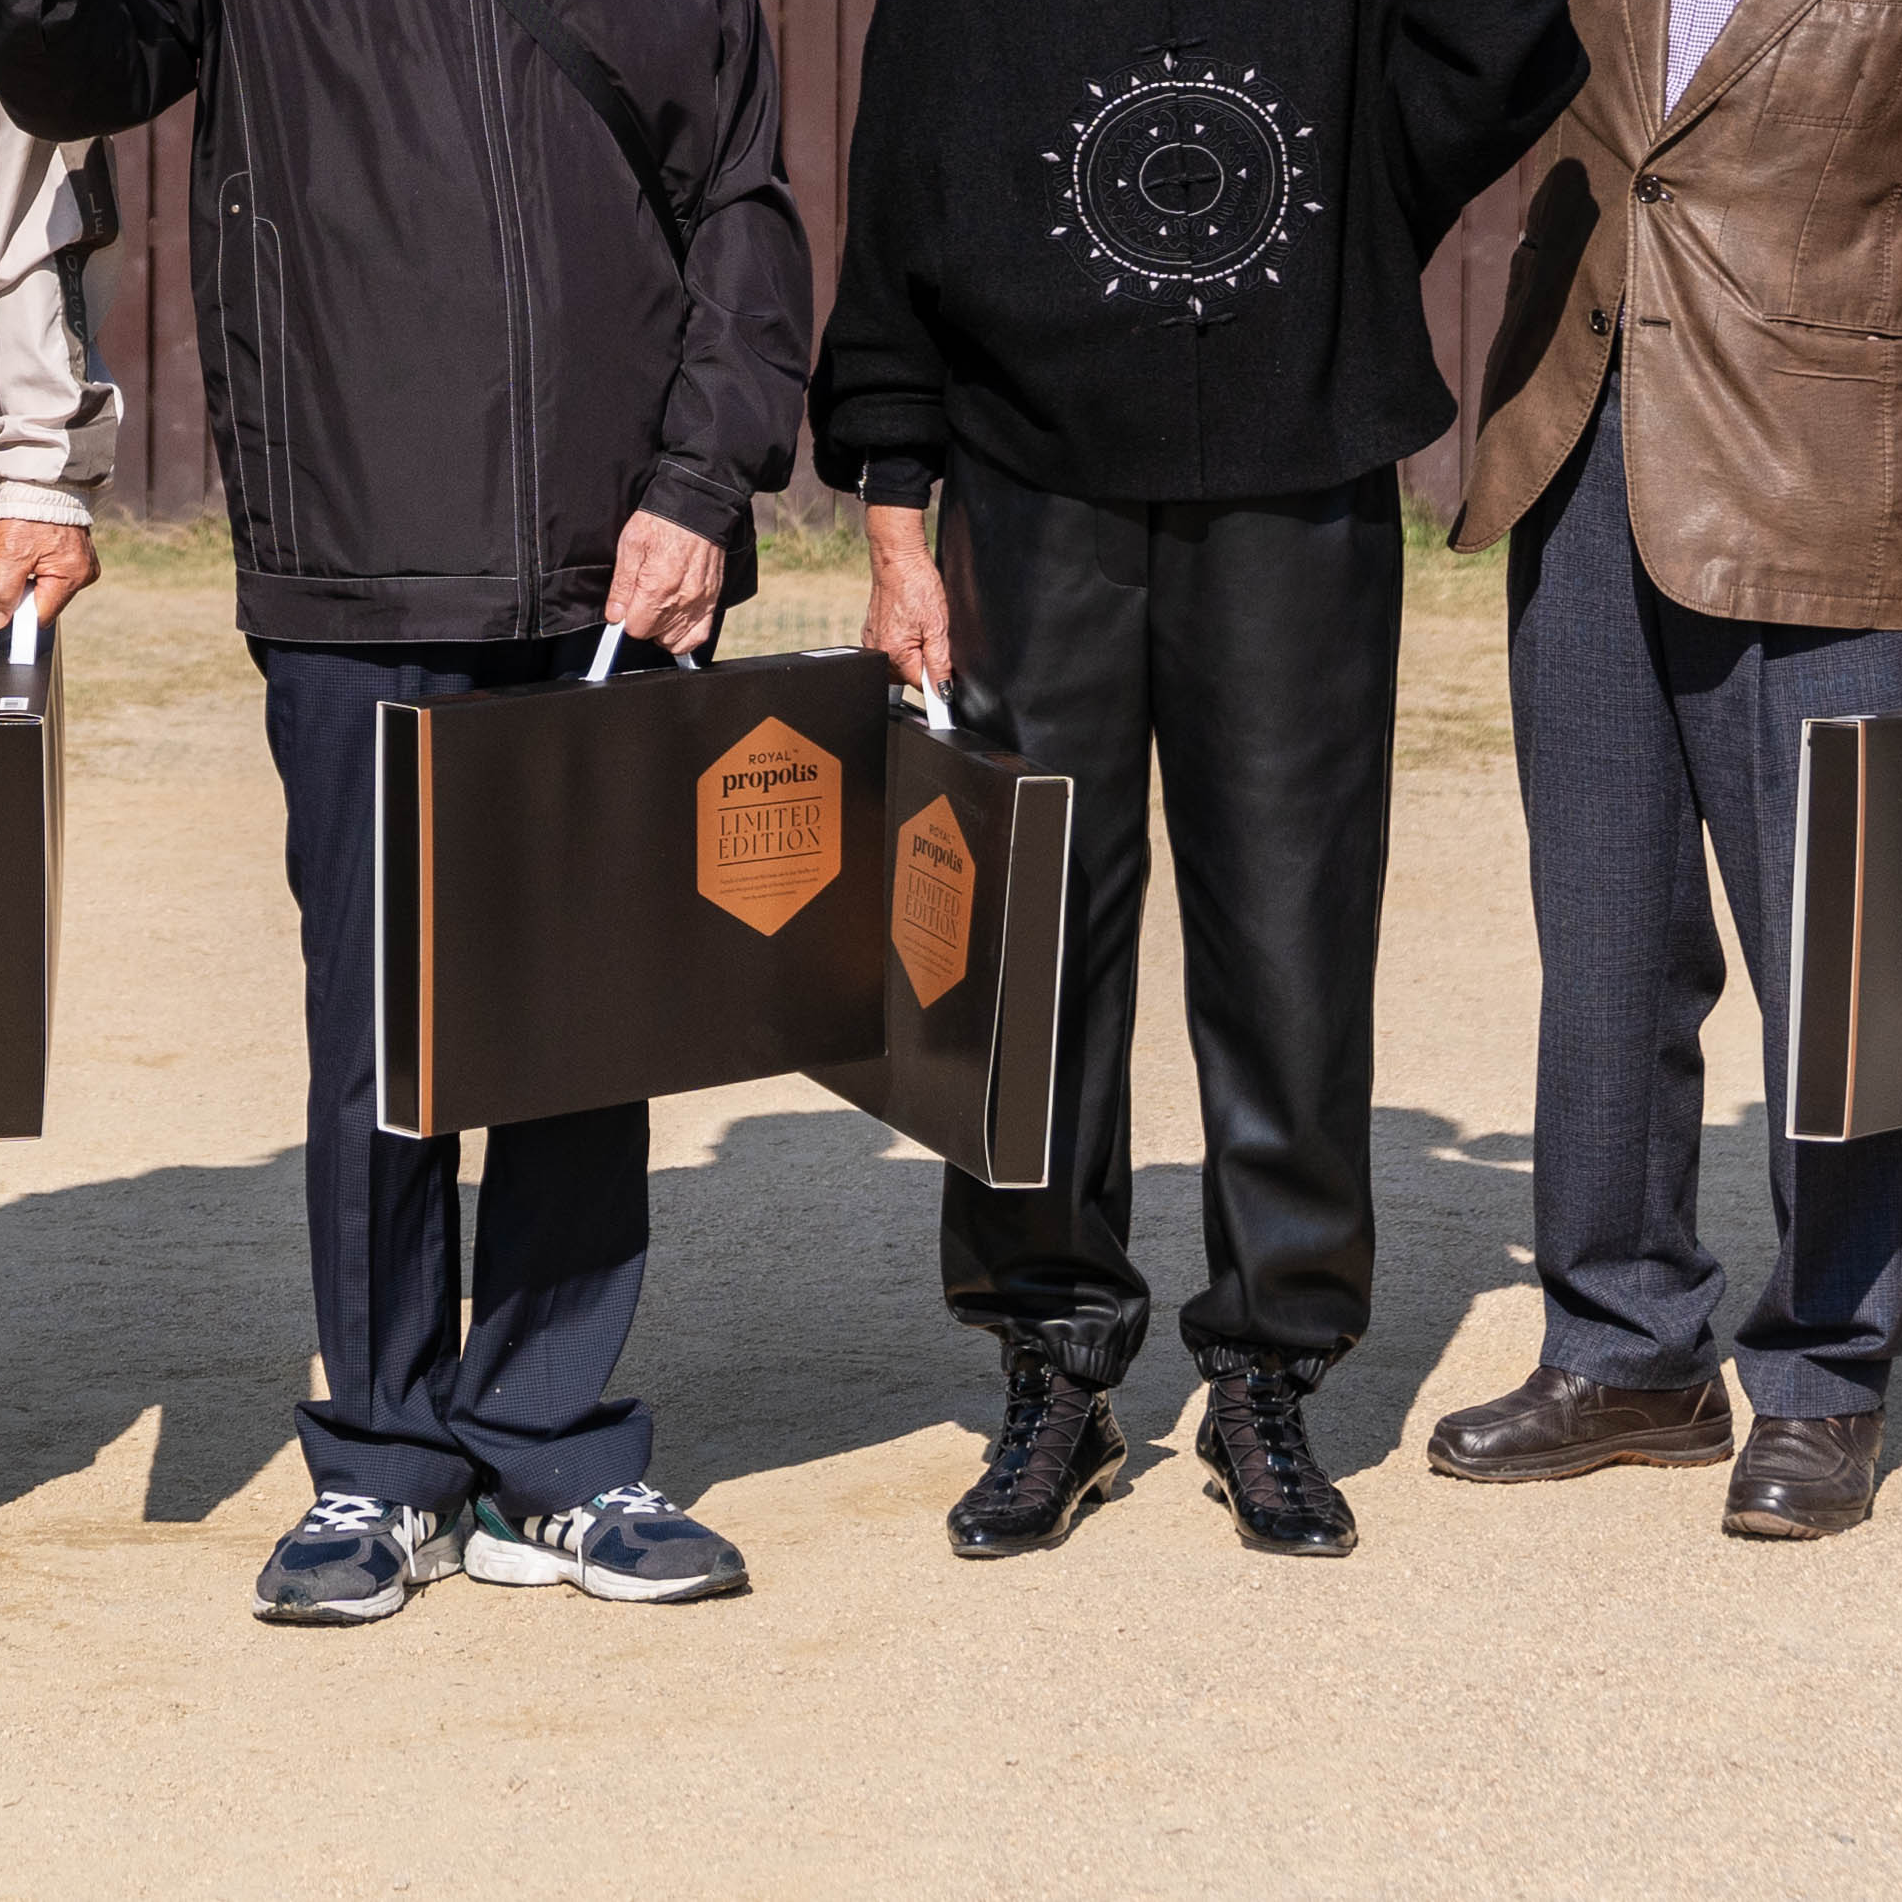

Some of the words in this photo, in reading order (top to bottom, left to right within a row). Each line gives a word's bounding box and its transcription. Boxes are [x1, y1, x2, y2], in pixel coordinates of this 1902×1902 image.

[748, 750, 792, 766] ROYAL
[721, 762, 819, 799] propolis
[720, 804, 821, 836] LIMITED
[718, 825, 821, 860] EDITION
[912, 833, 963, 874] propolis
[907, 871, 961, 918] LIMITED
[904, 893, 959, 940] EDITION
